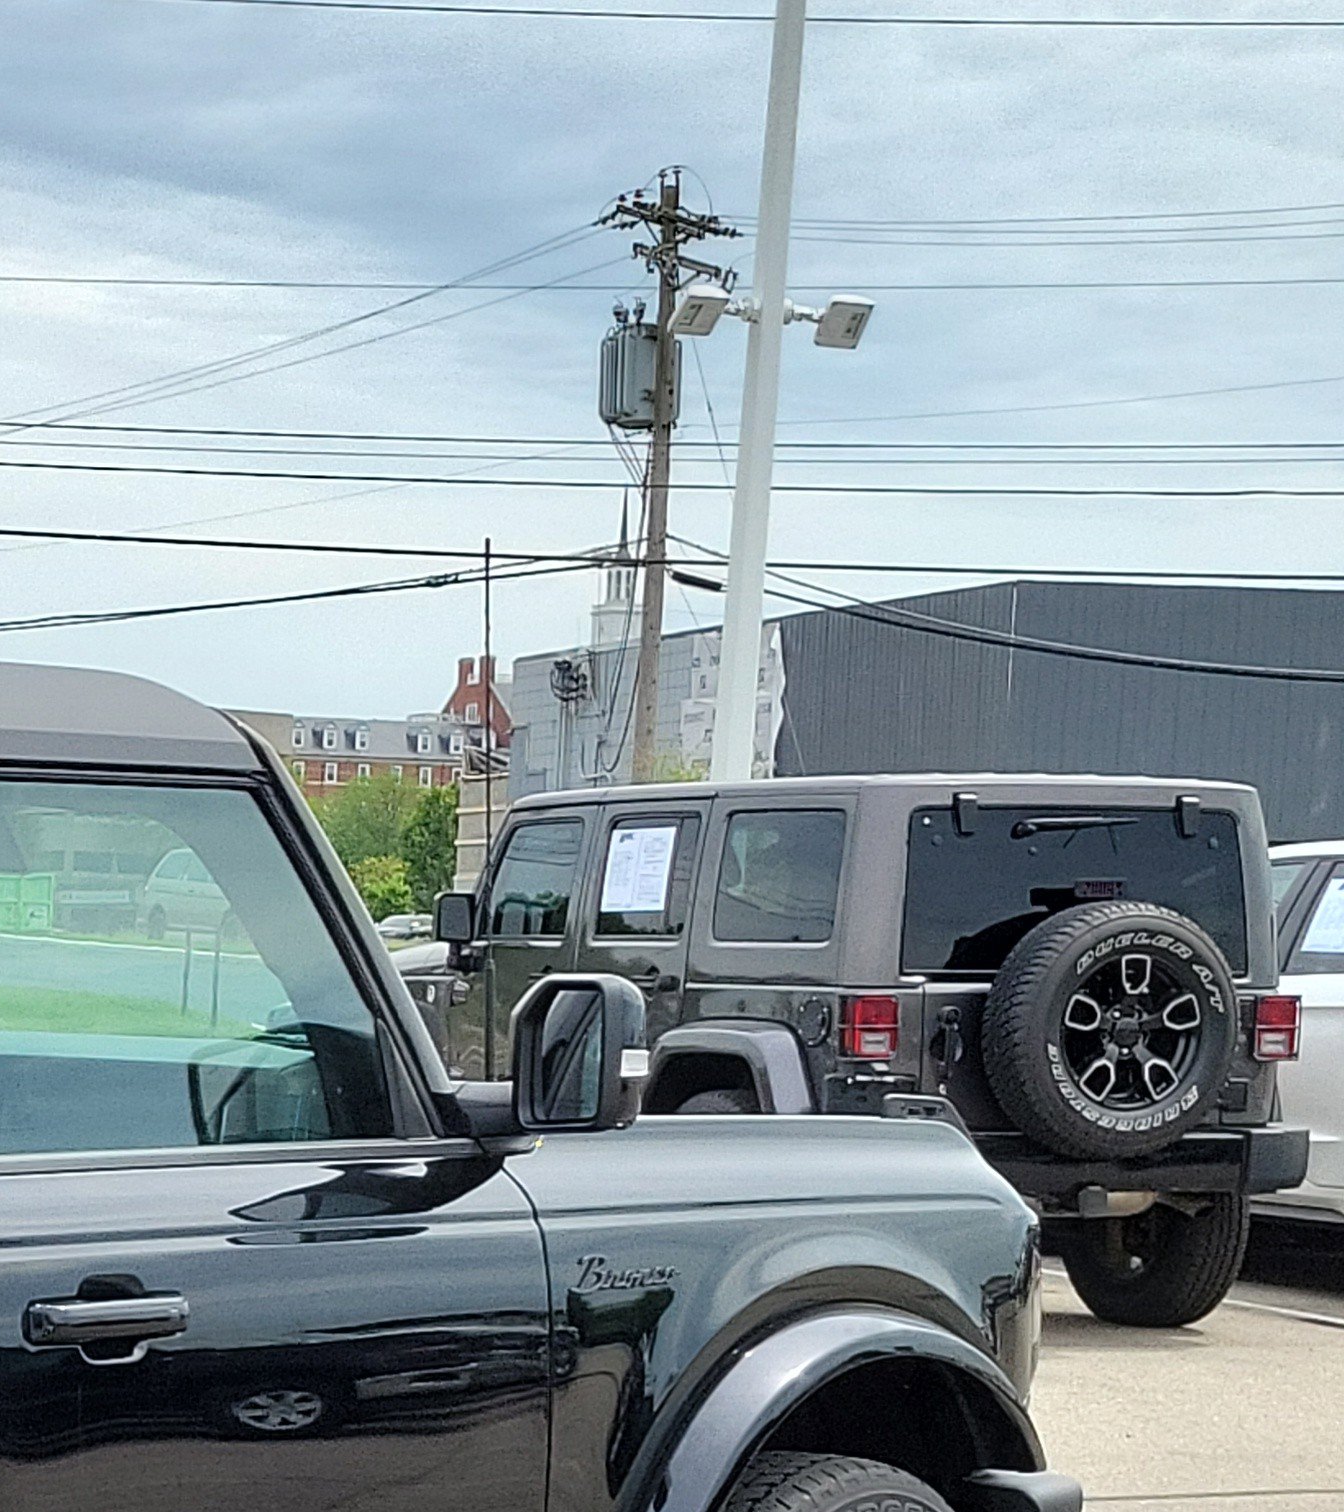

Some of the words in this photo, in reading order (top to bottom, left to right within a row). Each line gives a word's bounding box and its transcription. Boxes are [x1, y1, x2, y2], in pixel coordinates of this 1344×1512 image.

[1076, 931, 1194, 975] DUELER
[1192, 963, 1225, 1014] A/T
[1047, 1042, 1199, 1131] BRIDGESTONE
[569, 1253, 682, 1294] Bronco
